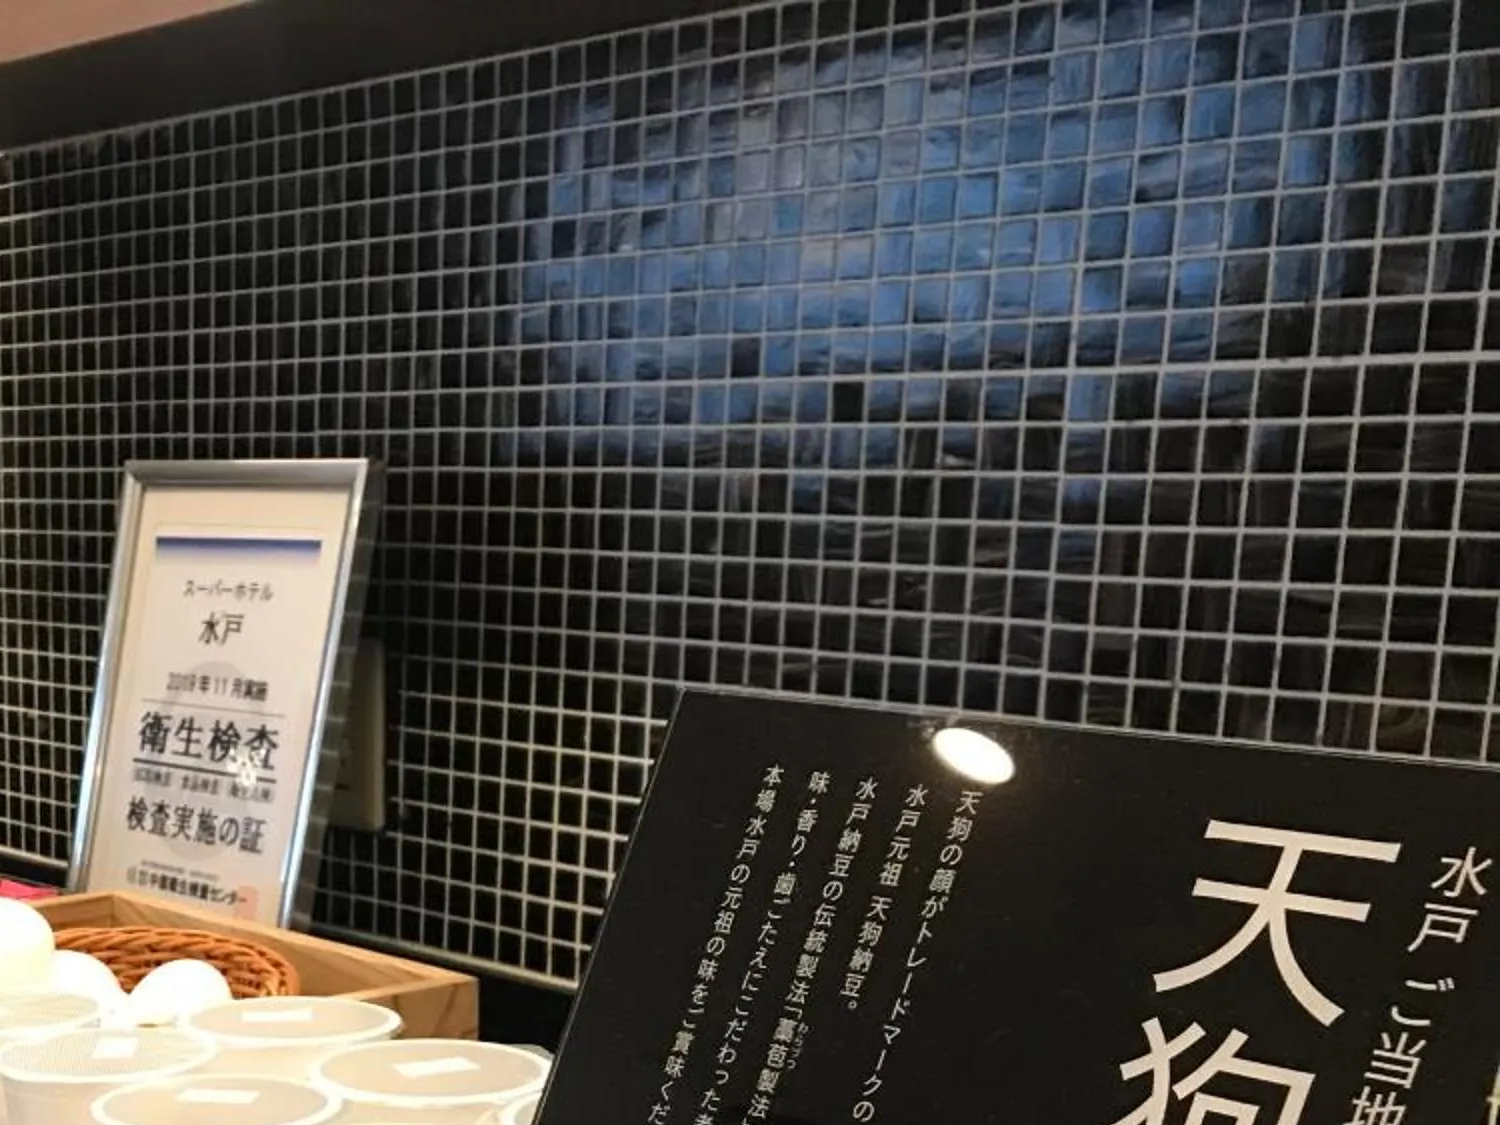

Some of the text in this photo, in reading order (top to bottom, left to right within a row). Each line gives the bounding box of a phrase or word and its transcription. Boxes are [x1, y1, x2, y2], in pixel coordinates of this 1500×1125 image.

[198, 611, 244, 646] 水戸
[137, 711, 280, 771] 衛生検査
[126, 796, 267, 854] 検査実施の証
[852, 789, 980, 1123] 天狗の顔がトレードマークの
